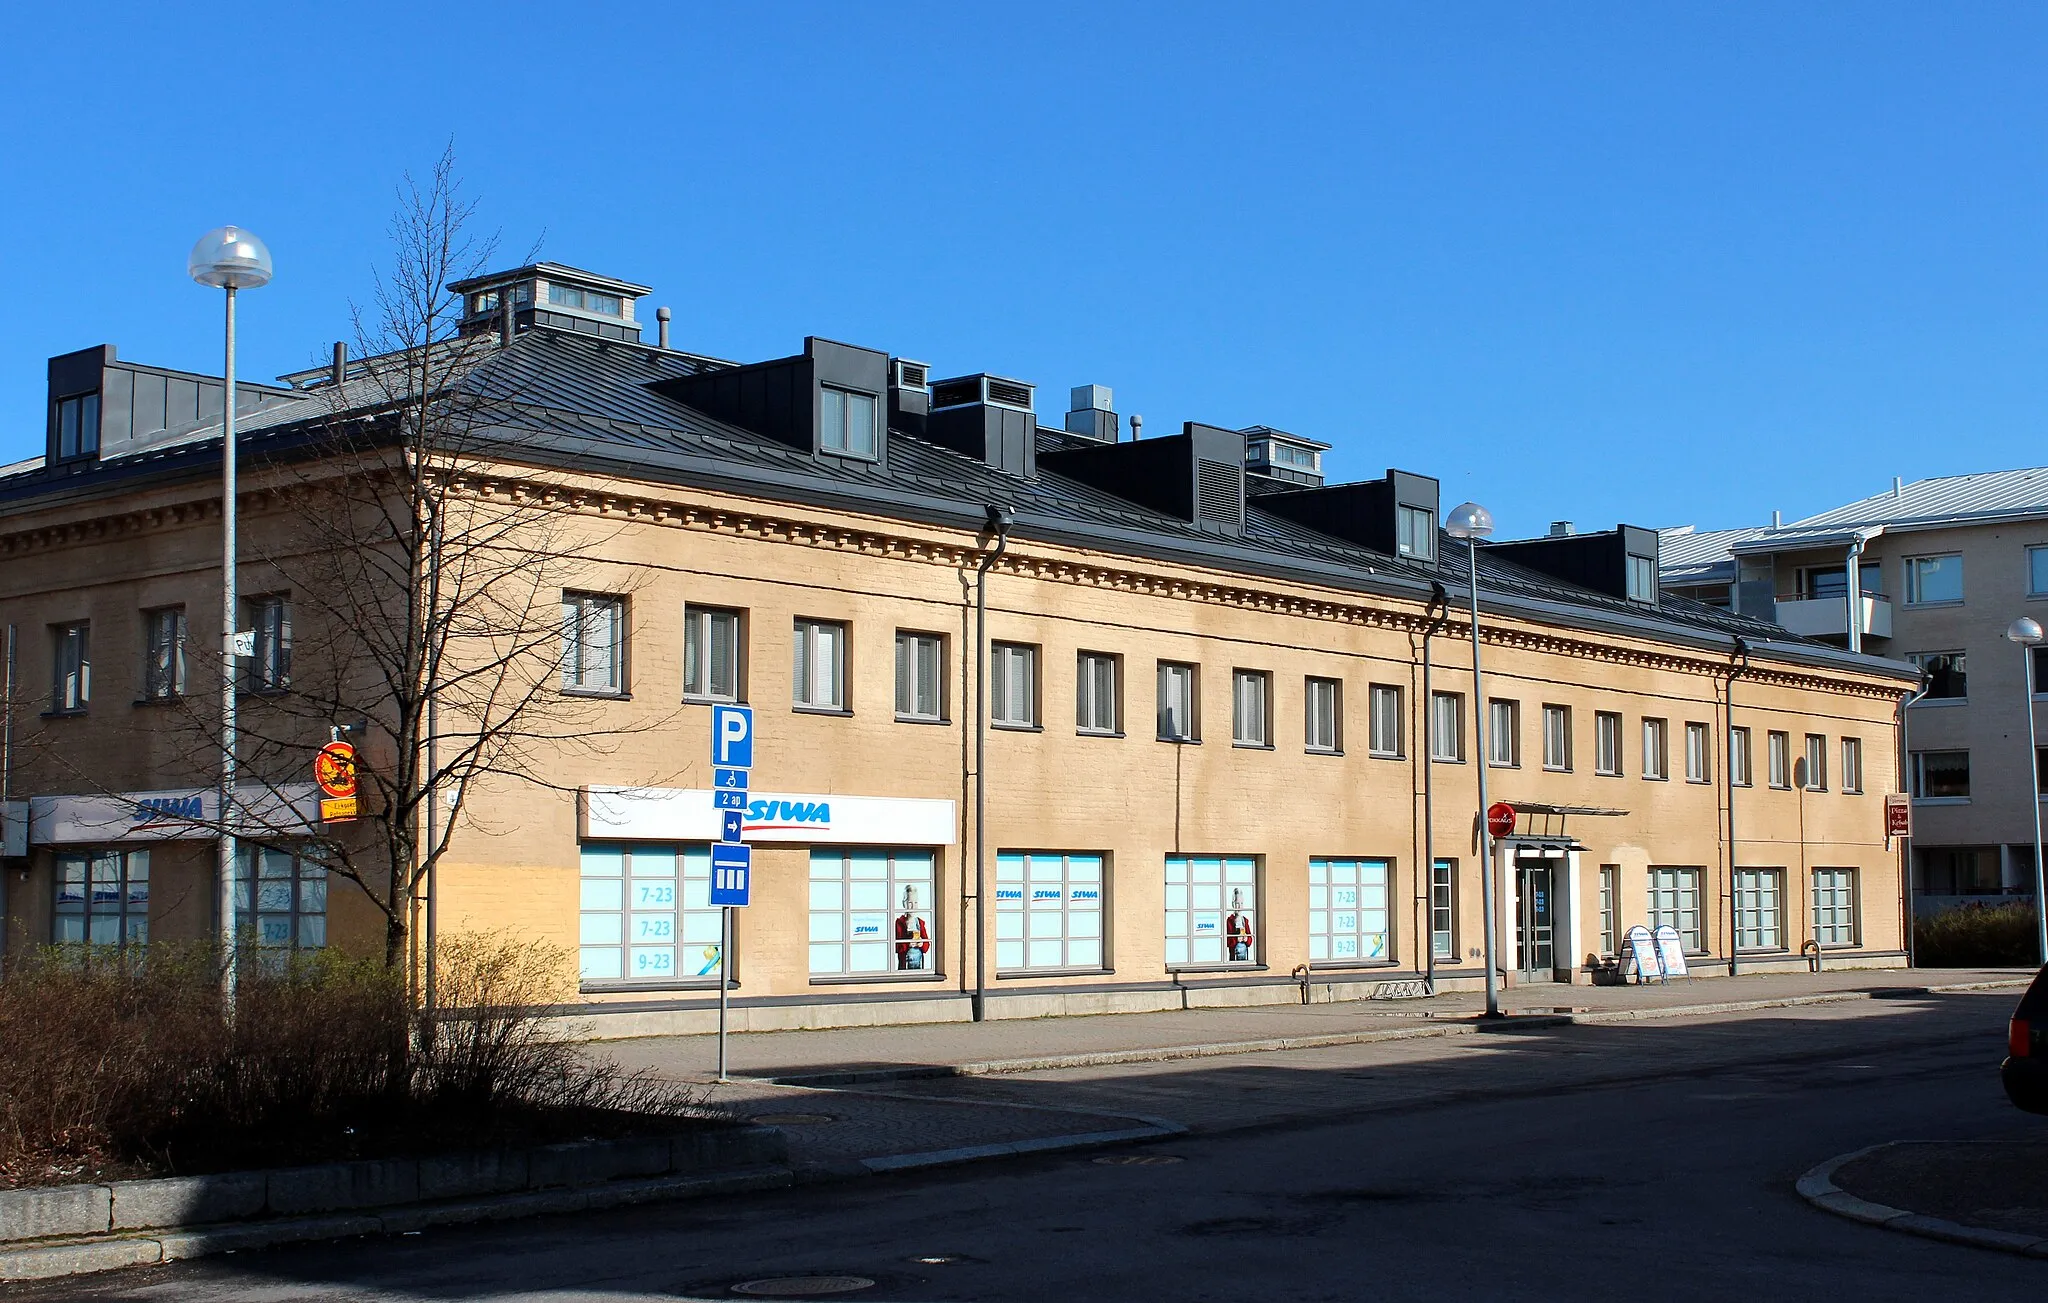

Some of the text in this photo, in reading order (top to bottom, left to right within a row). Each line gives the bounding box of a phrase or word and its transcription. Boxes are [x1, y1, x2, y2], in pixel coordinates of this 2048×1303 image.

[721, 710, 748, 762] P
[722, 793, 741, 807] 2 ap
[743, 799, 831, 823] SIWA
[641, 886, 673, 903] 7-23
[1033, 890, 1061, 899] SIWA
[1071, 890, 1098, 899] SIWA
[1337, 891, 1356, 903] 7-23
[641, 921, 671, 937] 7-23
[1338, 916, 1355, 928] 7-23
[1337, 941, 1356, 953] 9-23
[638, 954, 670, 970] 9-23
